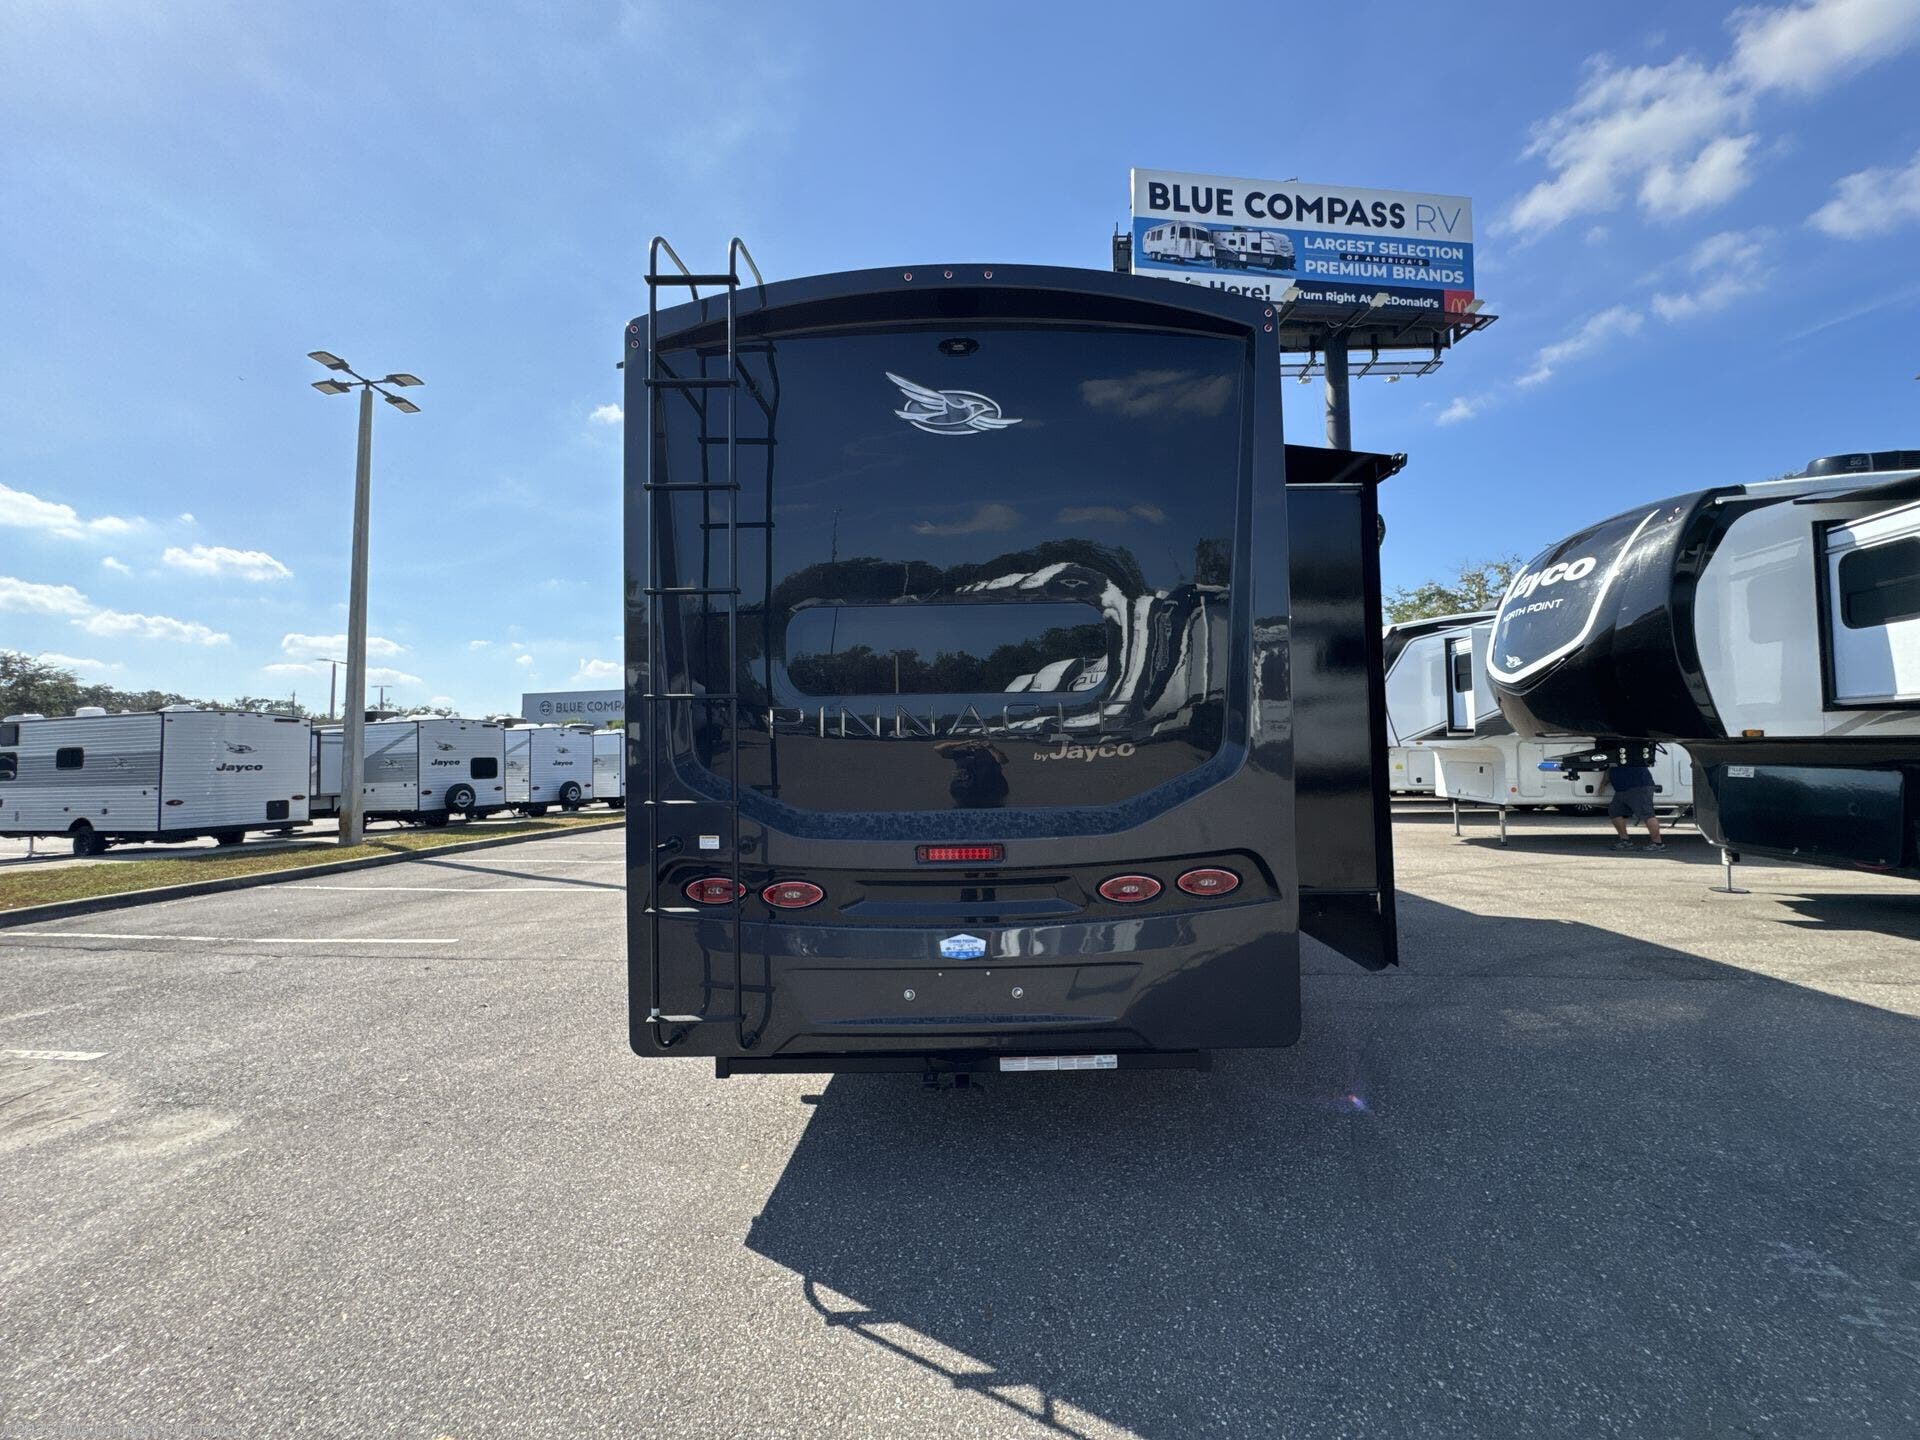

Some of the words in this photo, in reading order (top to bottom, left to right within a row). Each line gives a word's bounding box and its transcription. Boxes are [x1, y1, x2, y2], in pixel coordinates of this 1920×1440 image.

[1148, 182, 1233, 216] BLUE
[1245, 191, 1405, 229] COMPASS
[1416, 203, 1461, 234] RV
[1304, 236, 1375, 254] LARGEST
[1379, 242, 1464, 260] SELECTION
[1365, 256, 1424, 266] AMERICA'S
[1305, 260, 1387, 278] PREMIUM
[1392, 267, 1464, 284] BRANDS
[1297, 290, 1323, 301] Turn
[1326, 291, 1357, 304] Right
[1359, 293, 1372, 303] At
[1385, 295, 1439, 308] cDonald's
[1527, 598, 1564, 614] POINT
[556, 701, 583, 713] BLUE
[587, 700, 625, 713] COMP
[768, 701, 1131, 739] PINNACLE
[1033, 752, 1049, 762] by
[1049, 741, 1136, 762] Jayco
[216, 763, 263, 772] Jayco
[431, 759, 460, 767] Jayco
